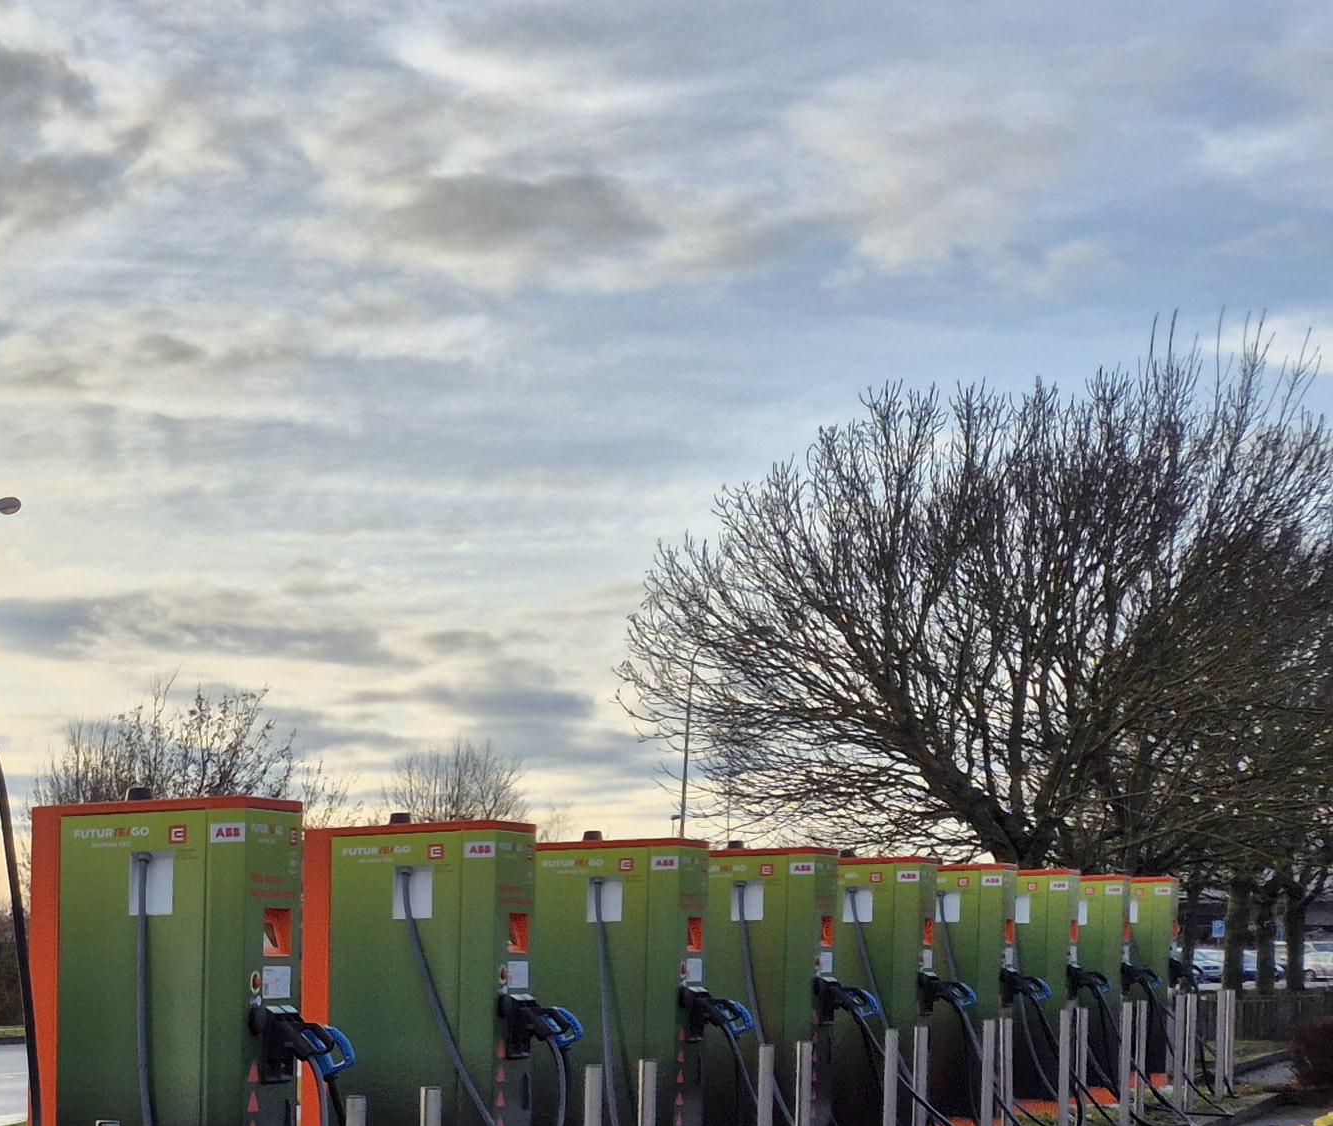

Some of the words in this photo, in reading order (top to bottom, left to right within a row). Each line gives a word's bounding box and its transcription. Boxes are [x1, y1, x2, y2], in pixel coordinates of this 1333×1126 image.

[73, 826, 150, 839] FUTUR/E/GO
[215, 827, 240, 838] ABB
[469, 845, 491, 854] ABB
[655, 858, 675, 867] ABB
